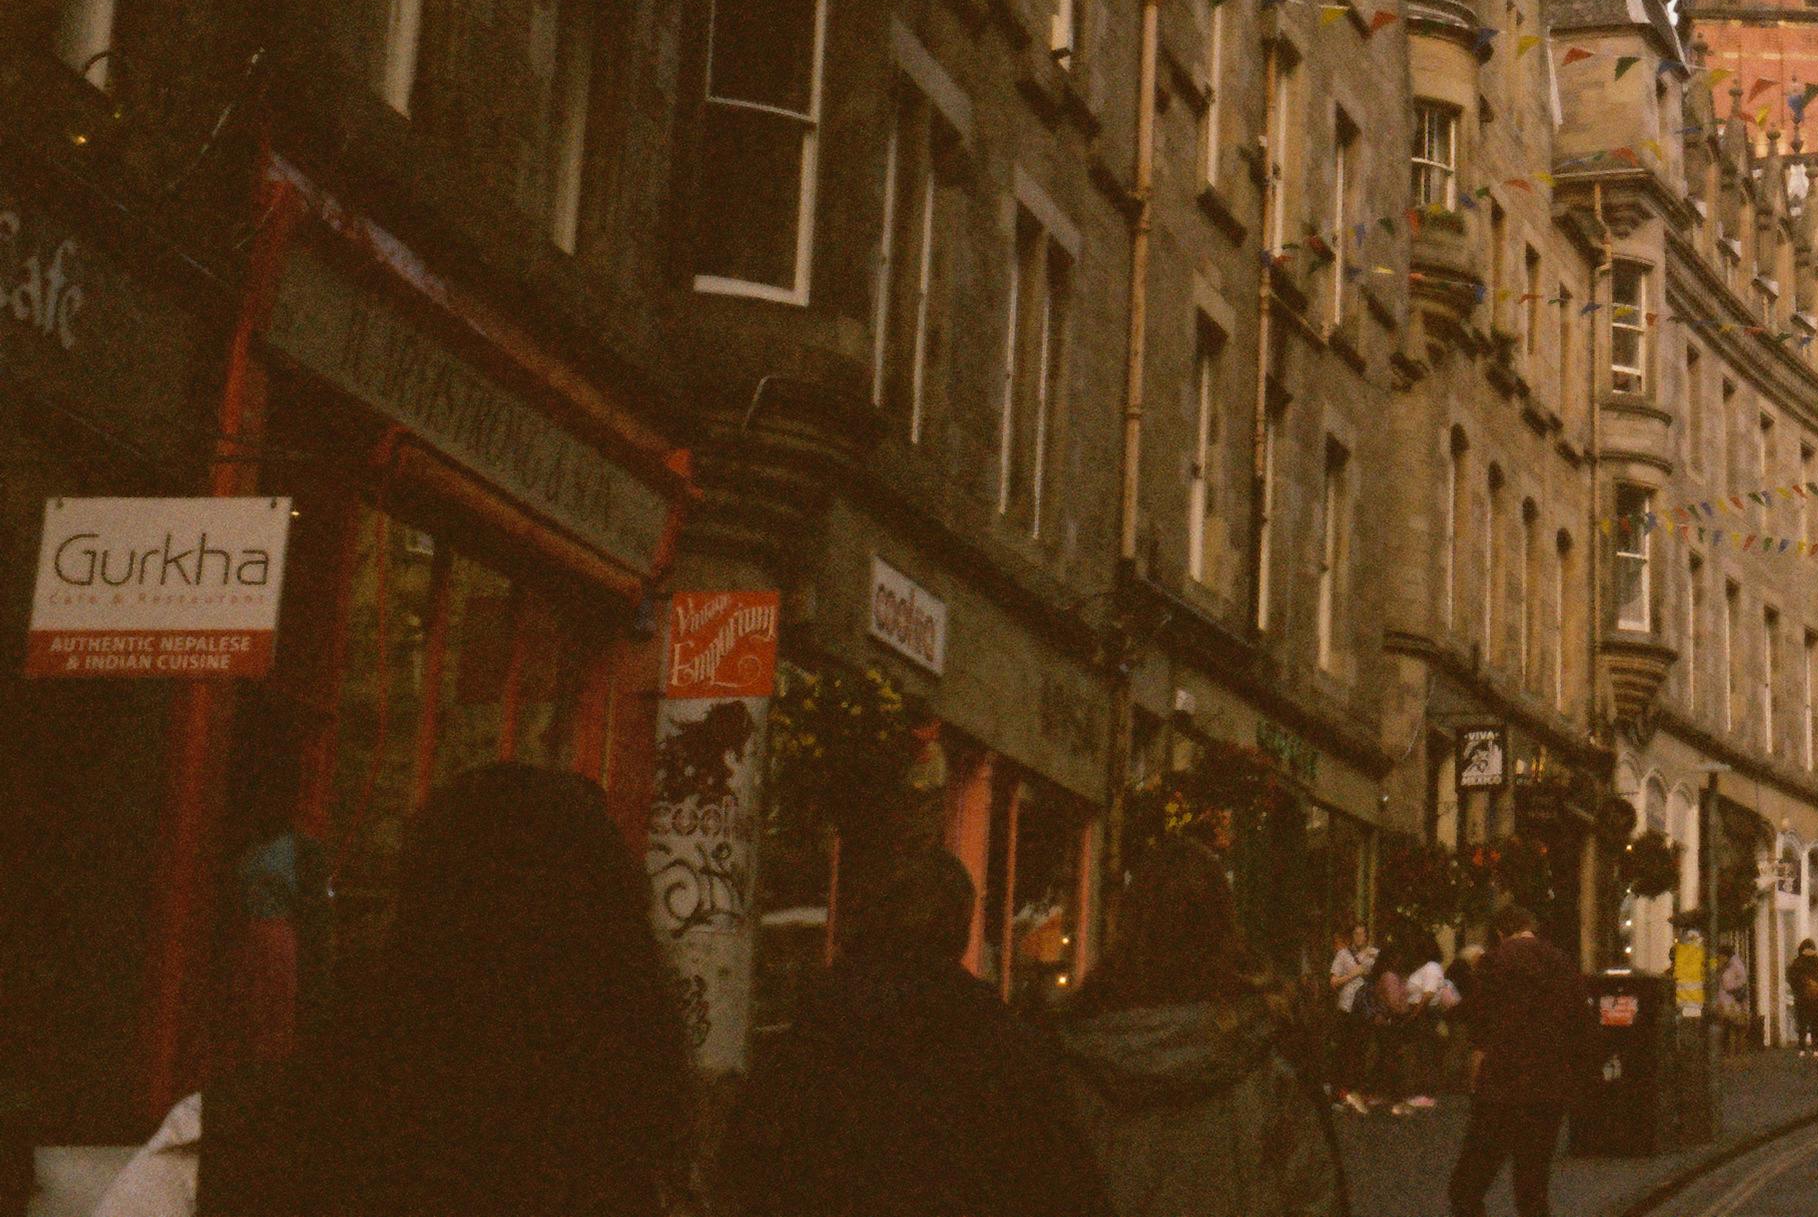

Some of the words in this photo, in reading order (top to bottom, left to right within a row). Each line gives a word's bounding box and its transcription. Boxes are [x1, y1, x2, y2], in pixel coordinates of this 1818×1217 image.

[54, 532, 270, 587] Gurkha
[49, 636, 155, 653] AUTHENTIC
[159, 636, 252, 653] NEPALESE
[65, 656, 79, 671] &
[84, 655, 152, 671] INDIAN
[156, 654, 232, 670] CUISINE
